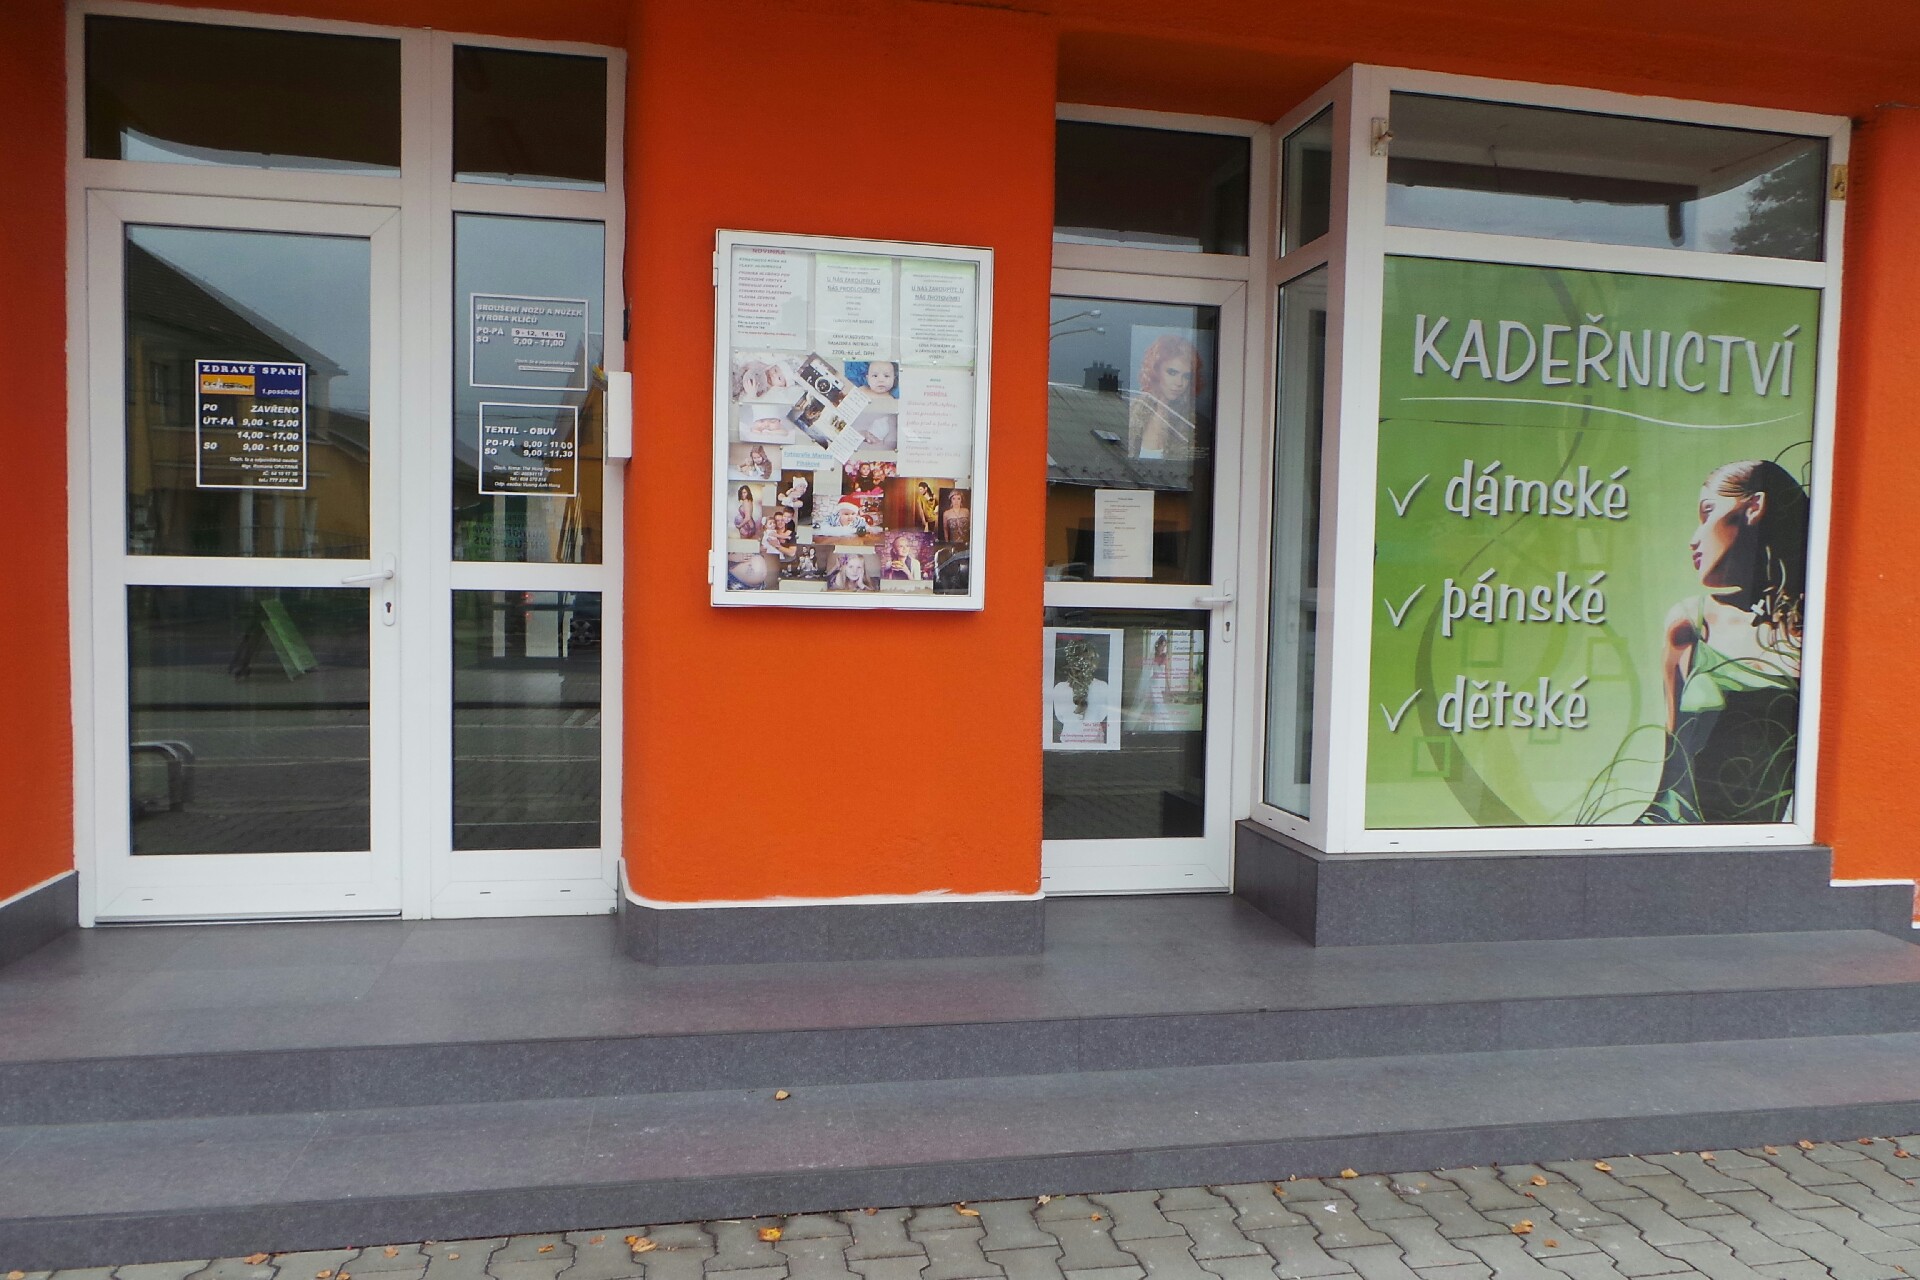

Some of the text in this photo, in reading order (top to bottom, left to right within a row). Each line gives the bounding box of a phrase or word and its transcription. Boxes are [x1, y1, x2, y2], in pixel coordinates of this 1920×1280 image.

[1413, 312, 1800, 396] KADEŘNICTVÍ
[202, 364, 302, 376] ZDRAVÉ SPANÍ
[202, 403, 299, 414] PO ZAVŘENO
[242, 418, 263, 427] 9,00
[272, 419, 299, 428] 12,00
[485, 426, 519, 434] TEXTIL
[236, 431, 263, 440] 14,00
[272, 432, 299, 441] 17,00
[203, 442, 218, 450] SO
[242, 443, 264, 452] 9,00
[273, 444, 299, 452] 11,00
[486, 438, 515, 447] PO-PÁ
[523, 450, 542, 458] 9,00
[1445, 459, 1629, 520] dámské
[1441, 568, 1607, 638] pánské
[1436, 674, 1588, 732] dětské
